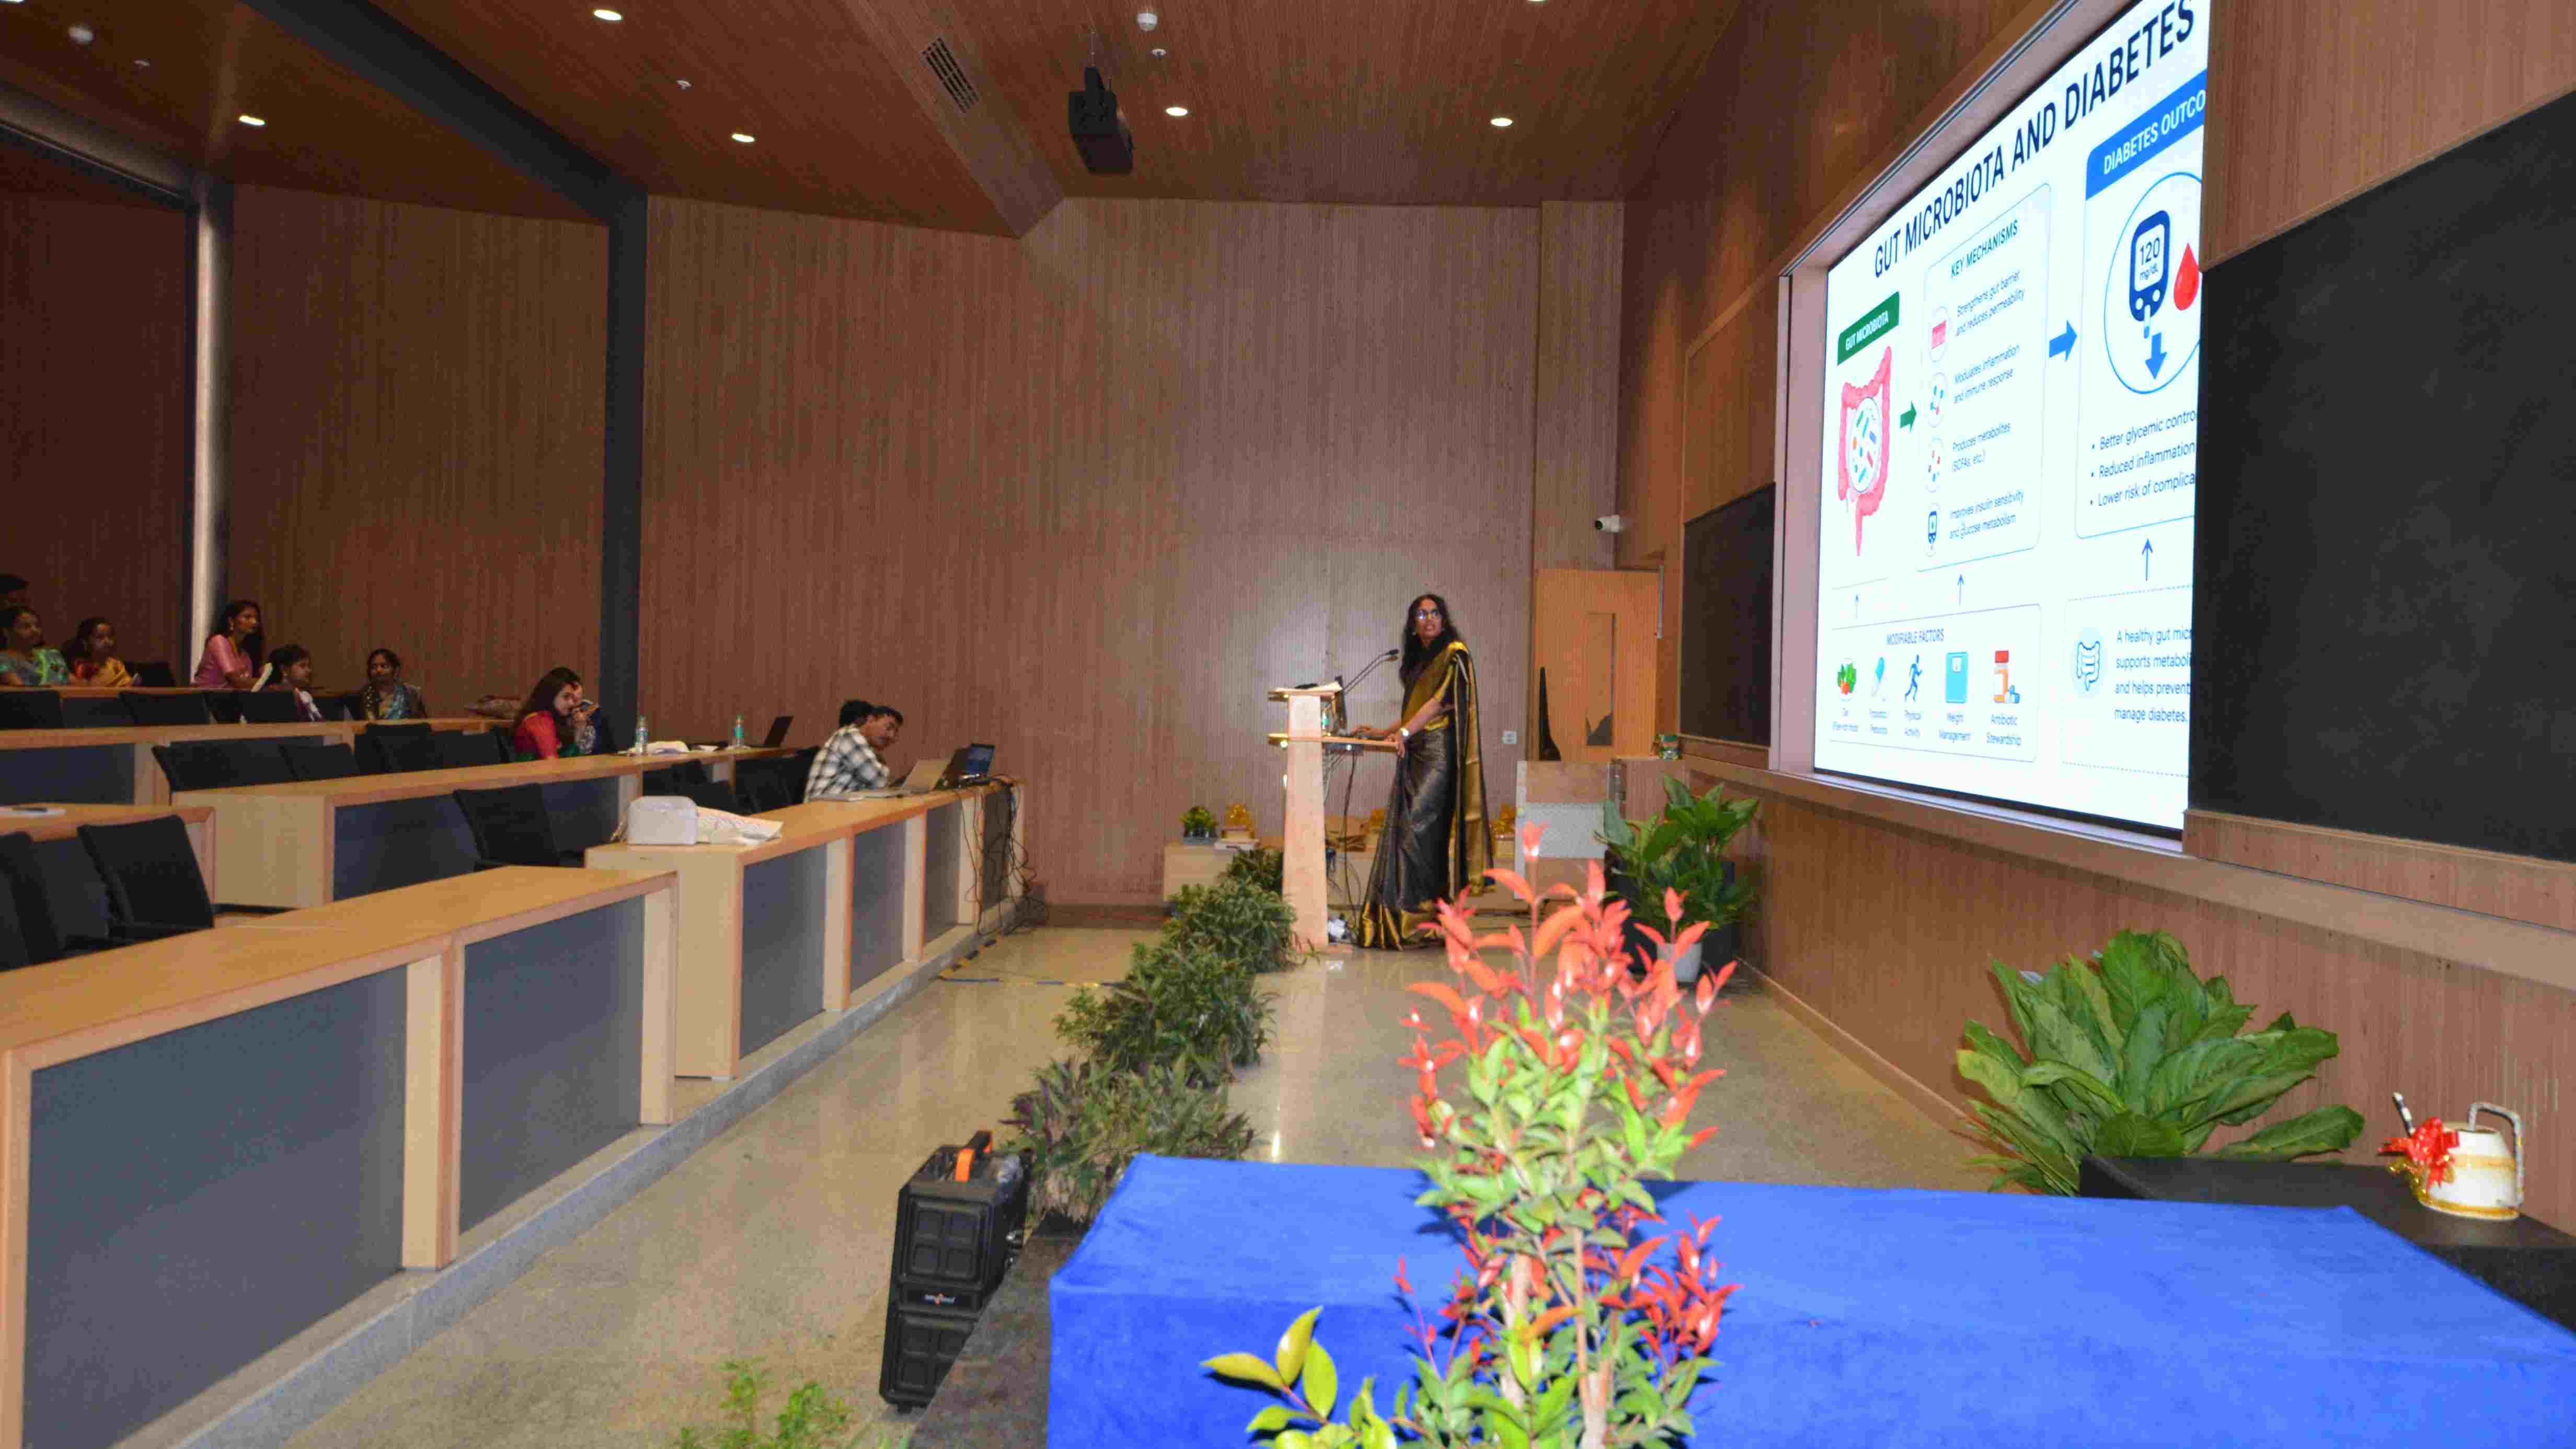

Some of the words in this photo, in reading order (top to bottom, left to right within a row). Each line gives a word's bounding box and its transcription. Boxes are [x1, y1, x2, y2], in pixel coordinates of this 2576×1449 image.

[1874, 228, 1901, 278] GUT
[1905, 145, 2005, 256] MICROBIOTA
[2011, 102, 2056, 172] AND
[2064, 0, 2194, 129] DIABETES
[2103, 122, 2158, 175] DIABETES
[1951, 259, 1964, 278] KEY
[1966, 220, 2018, 268] MECHANISMS
[2140, 237, 2160, 266] 120
[1845, 334, 1856, 351] GUT
[1856, 310, 1889, 343] MICROBIOTA
[2099, 433, 2124, 451] Better
[2125, 419, 2163, 445] glycemic
[2099, 455, 2134, 478] Reduced
[2136, 441, 2195, 468] inflammation
[2098, 490, 2122, 507] Lower
[2124, 482, 2140, 500] risk
[2142, 479, 2152, 497] of
[1886, 631, 1917, 645] MODIFIABLE
[1919, 628, 1944, 642] FACTORS
[2117, 630, 2123, 643] A
[2124, 628, 2154, 646] healthy
[2157, 628, 2170, 646] gut
[2115, 656, 2151, 672] supports
[2115, 681, 2130, 694] and
[2132, 680, 2154, 698] helps
[2114, 709, 2146, 723] manage
